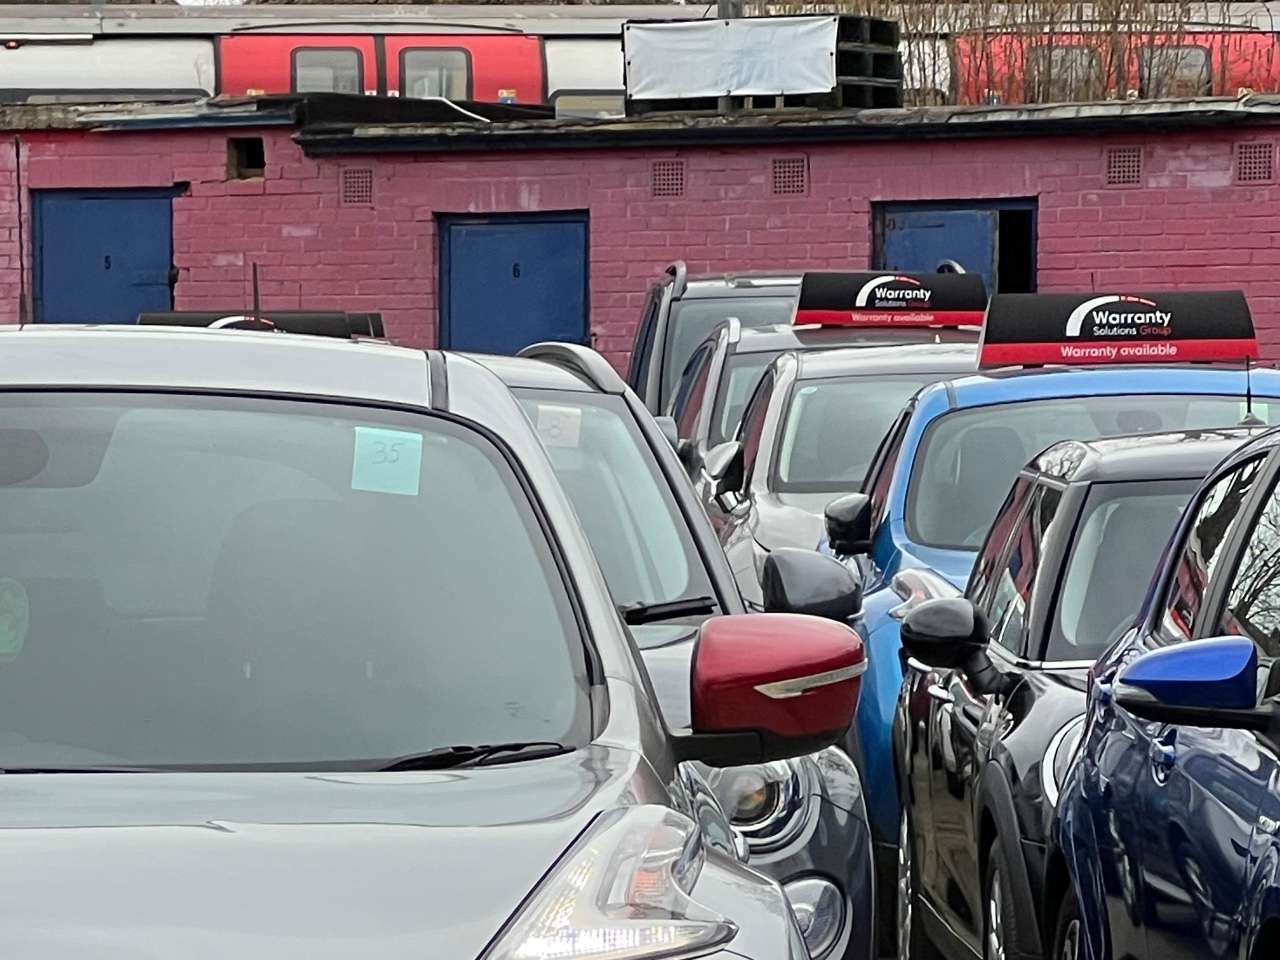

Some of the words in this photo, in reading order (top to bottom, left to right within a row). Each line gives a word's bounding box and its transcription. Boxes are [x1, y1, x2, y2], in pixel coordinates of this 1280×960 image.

[104, 255, 112, 270] 5
[512, 263, 521, 279] 6
[875, 287, 932, 301] Warranty
[851, 312, 892, 323] Warranty
[893, 312, 934, 322] available
[1092, 310, 1172, 326] Warranty
[1092, 325, 1137, 336] Solutions
[1139, 326, 1172, 338] Group
[1060, 346, 1118, 359] Warranty
[1120, 344, 1177, 356] available
[372, 441, 405, 464] 35
